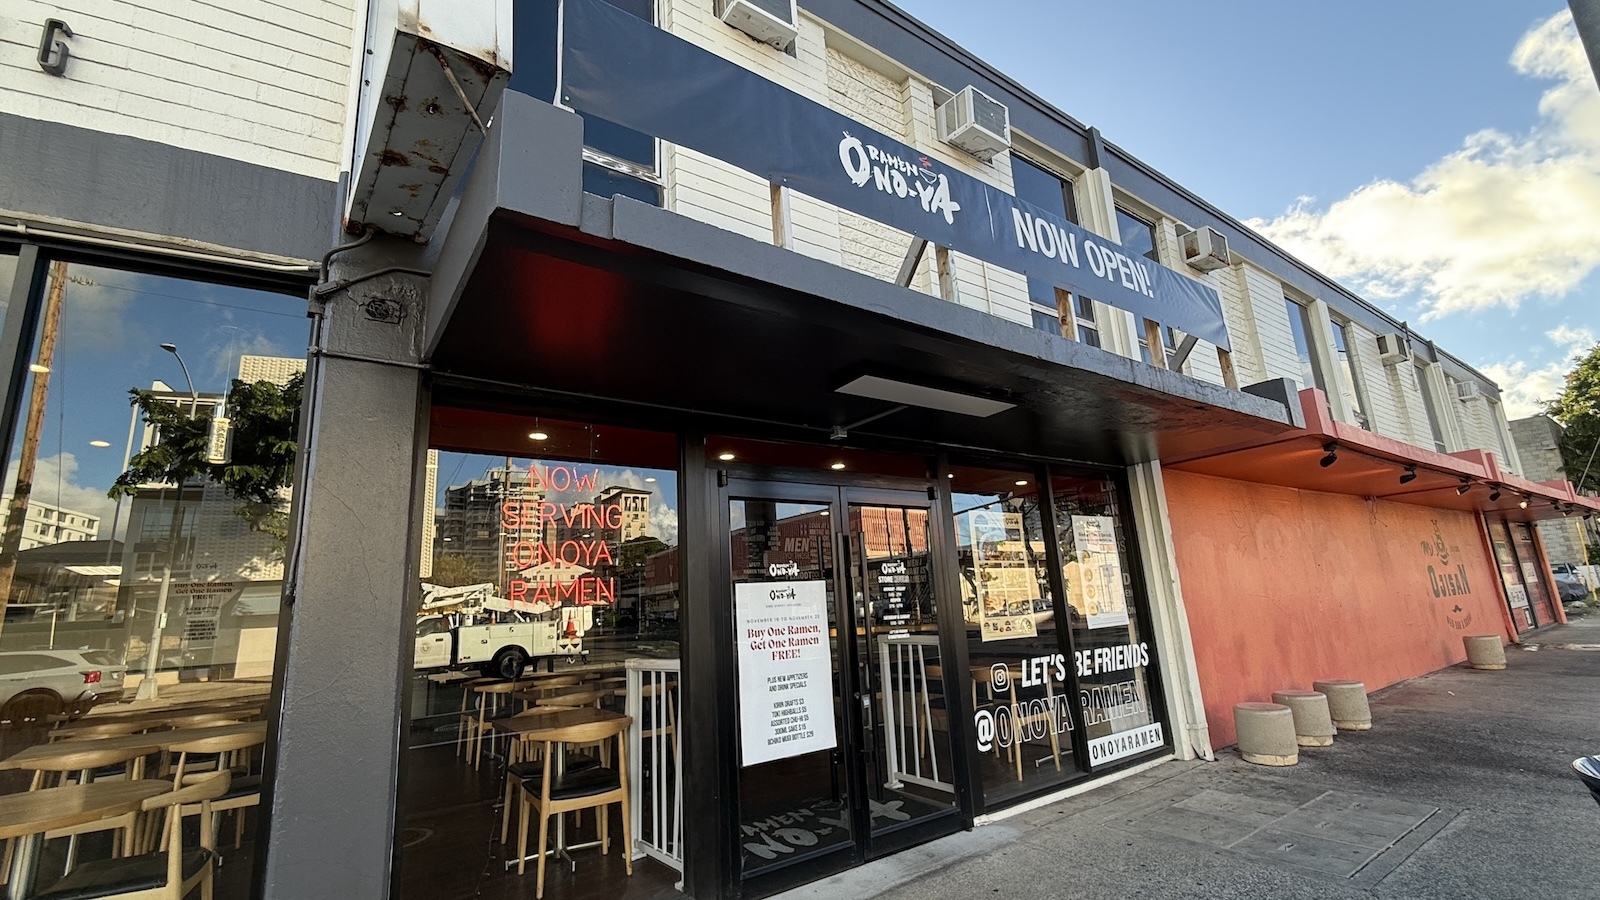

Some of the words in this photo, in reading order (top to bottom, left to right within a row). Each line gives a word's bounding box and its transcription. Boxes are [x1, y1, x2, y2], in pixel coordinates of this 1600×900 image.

[867, 144, 920, 176] RAMEN
[1011, 206, 1080, 269] NOW
[1084, 239, 1154, 298] OPEN!
[529, 464, 599, 492] NOW
[501, 502, 624, 530] SERVING
[512, 540, 614, 569] ONOYA
[509, 577, 616, 608] RAMEN
[747, 628, 766, 640] Buy
[767, 627, 786, 636] One
[787, 625, 821, 635] Ramen,
[750, 640, 766, 651] Get
[768, 639, 786, 649] One
[788, 636, 819, 647] Ramen
[772, 649, 801, 661] FREE!
[1021, 654, 1066, 688] LET'S
[1094, 642, 1149, 674] FRIENDS
[767, 676, 777, 684] PLUS
[787, 672, 808, 681] APPETIZERS
[778, 683, 789, 691] DRINK
[790, 681, 807, 690] SPECIALS
[784, 699, 798, 707] DRAFTS
[781, 707, 801, 716] HIGHBALLS
[974, 694, 1074, 752] @ONOYA
[1080, 680, 1146, 727] RAMEN
[770, 718, 790, 727] ASSORTED
[788, 725, 798, 733] SAKE
[792, 732, 806, 741] BOTTLE
[1092, 728, 1161, 760] ONOYARAMEN
